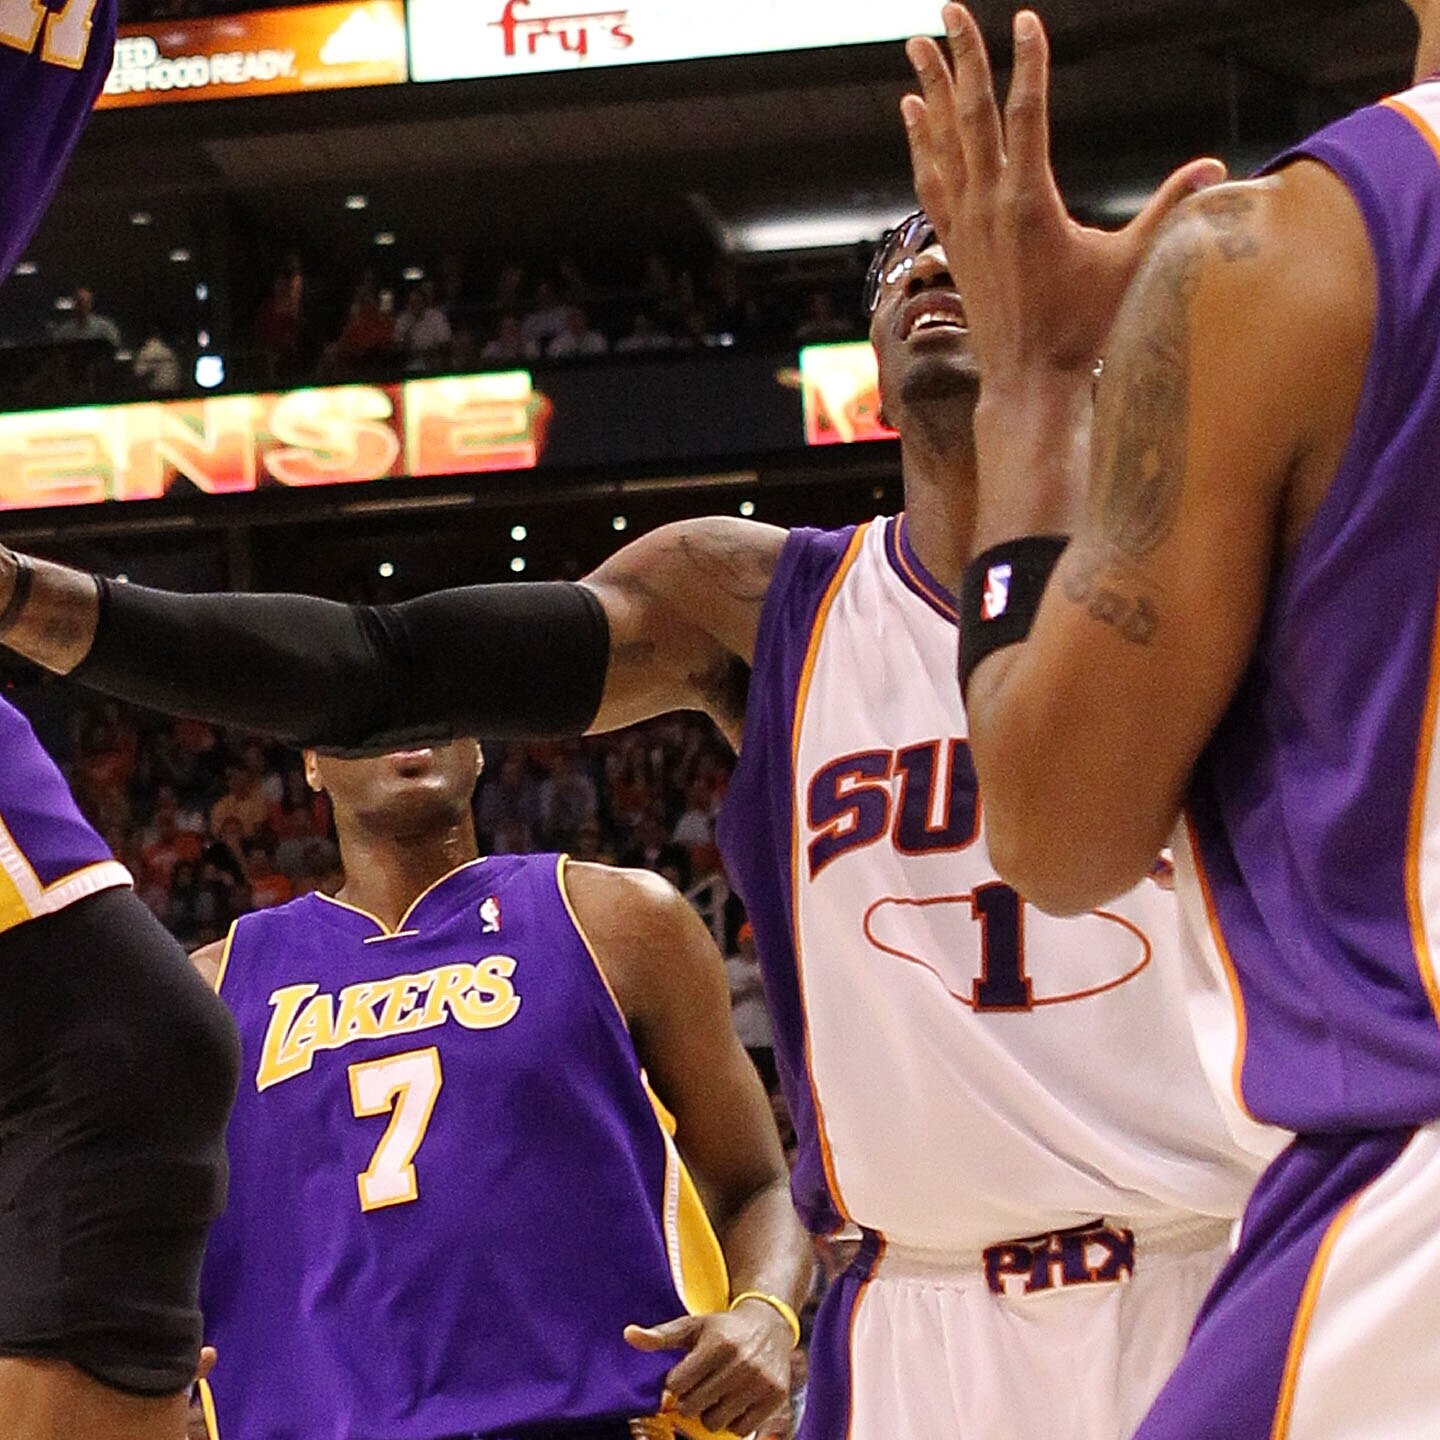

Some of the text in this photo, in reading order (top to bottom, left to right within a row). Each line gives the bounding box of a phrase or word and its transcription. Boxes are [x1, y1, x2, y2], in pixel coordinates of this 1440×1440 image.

[807, 738, 982, 883] SU
[971, 881, 1033, 1013] 1
[256, 955, 522, 1093] LAKERS
[348, 1046, 443, 1213] 7
